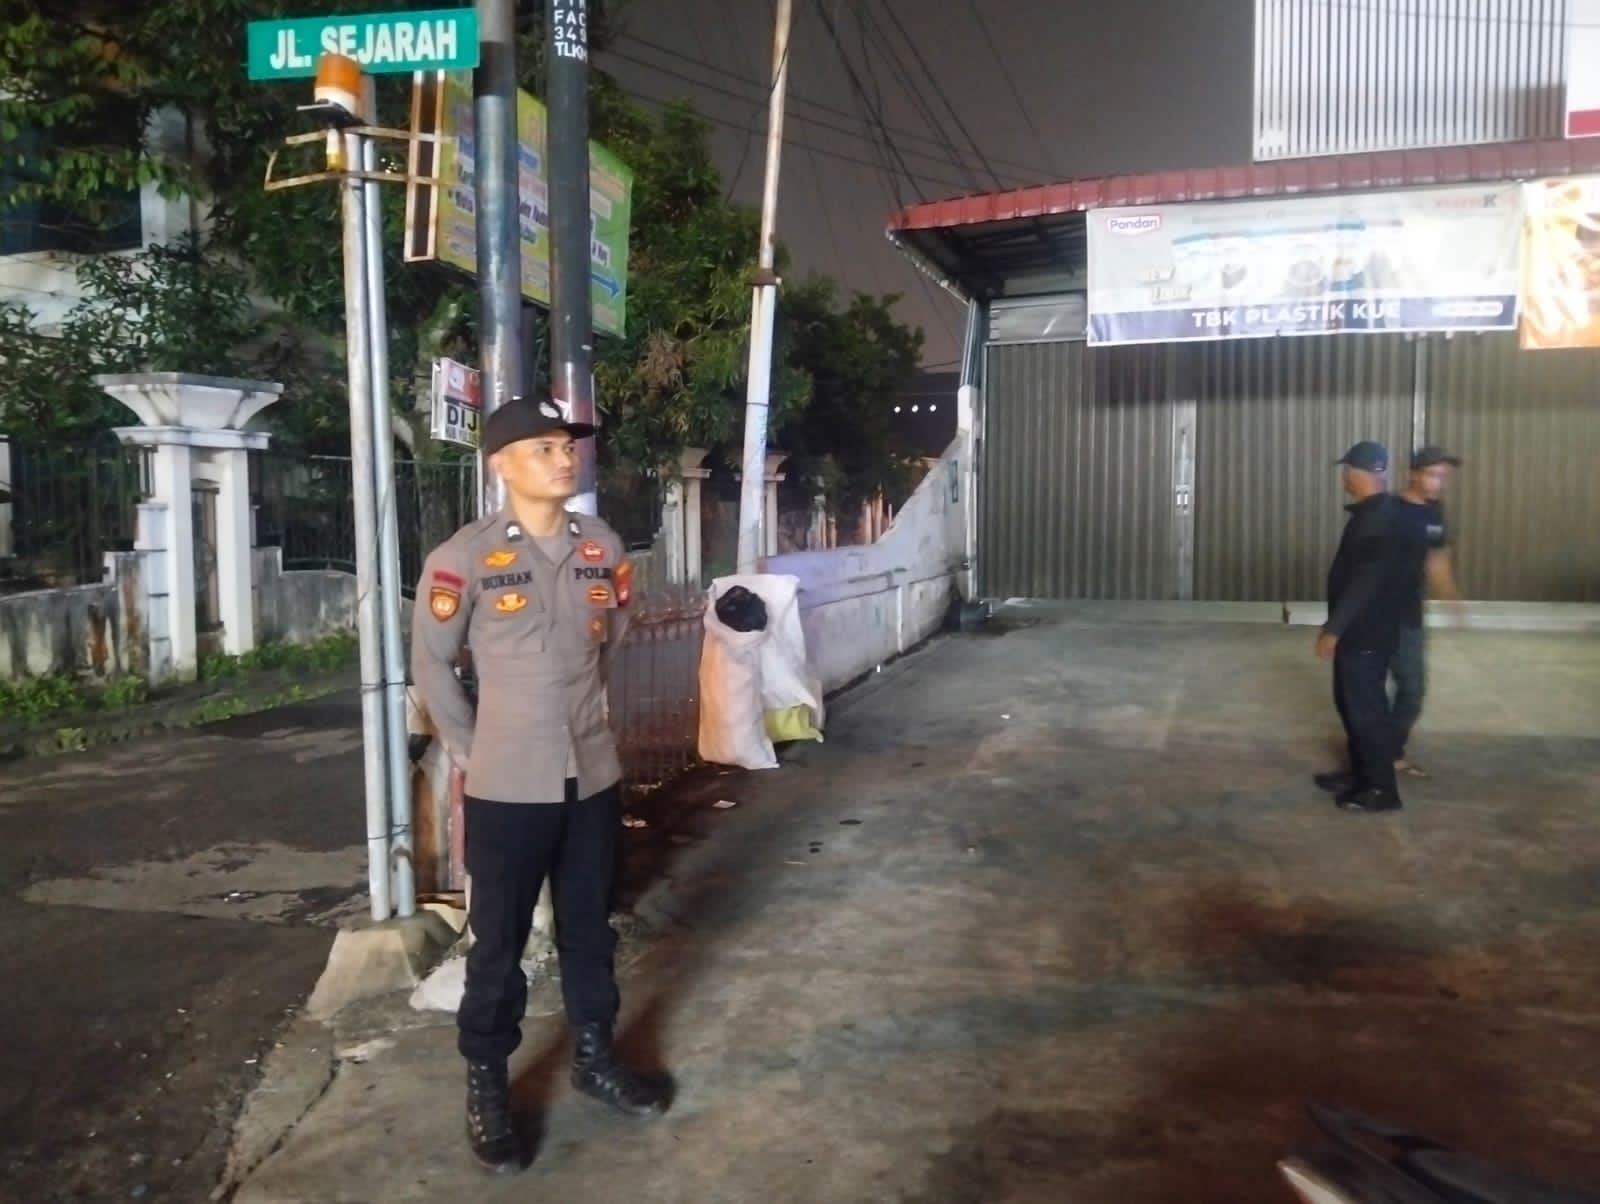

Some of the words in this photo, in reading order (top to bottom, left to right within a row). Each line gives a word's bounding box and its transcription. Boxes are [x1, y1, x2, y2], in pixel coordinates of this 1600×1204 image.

[269, 28, 312, 69] JL.
[320, 19, 457, 65] SEJARAH
[1109, 216, 1158, 230] Pandan
[1191, 311, 1236, 329] TBK
[1245, 303, 1345, 323] PLASTIK
